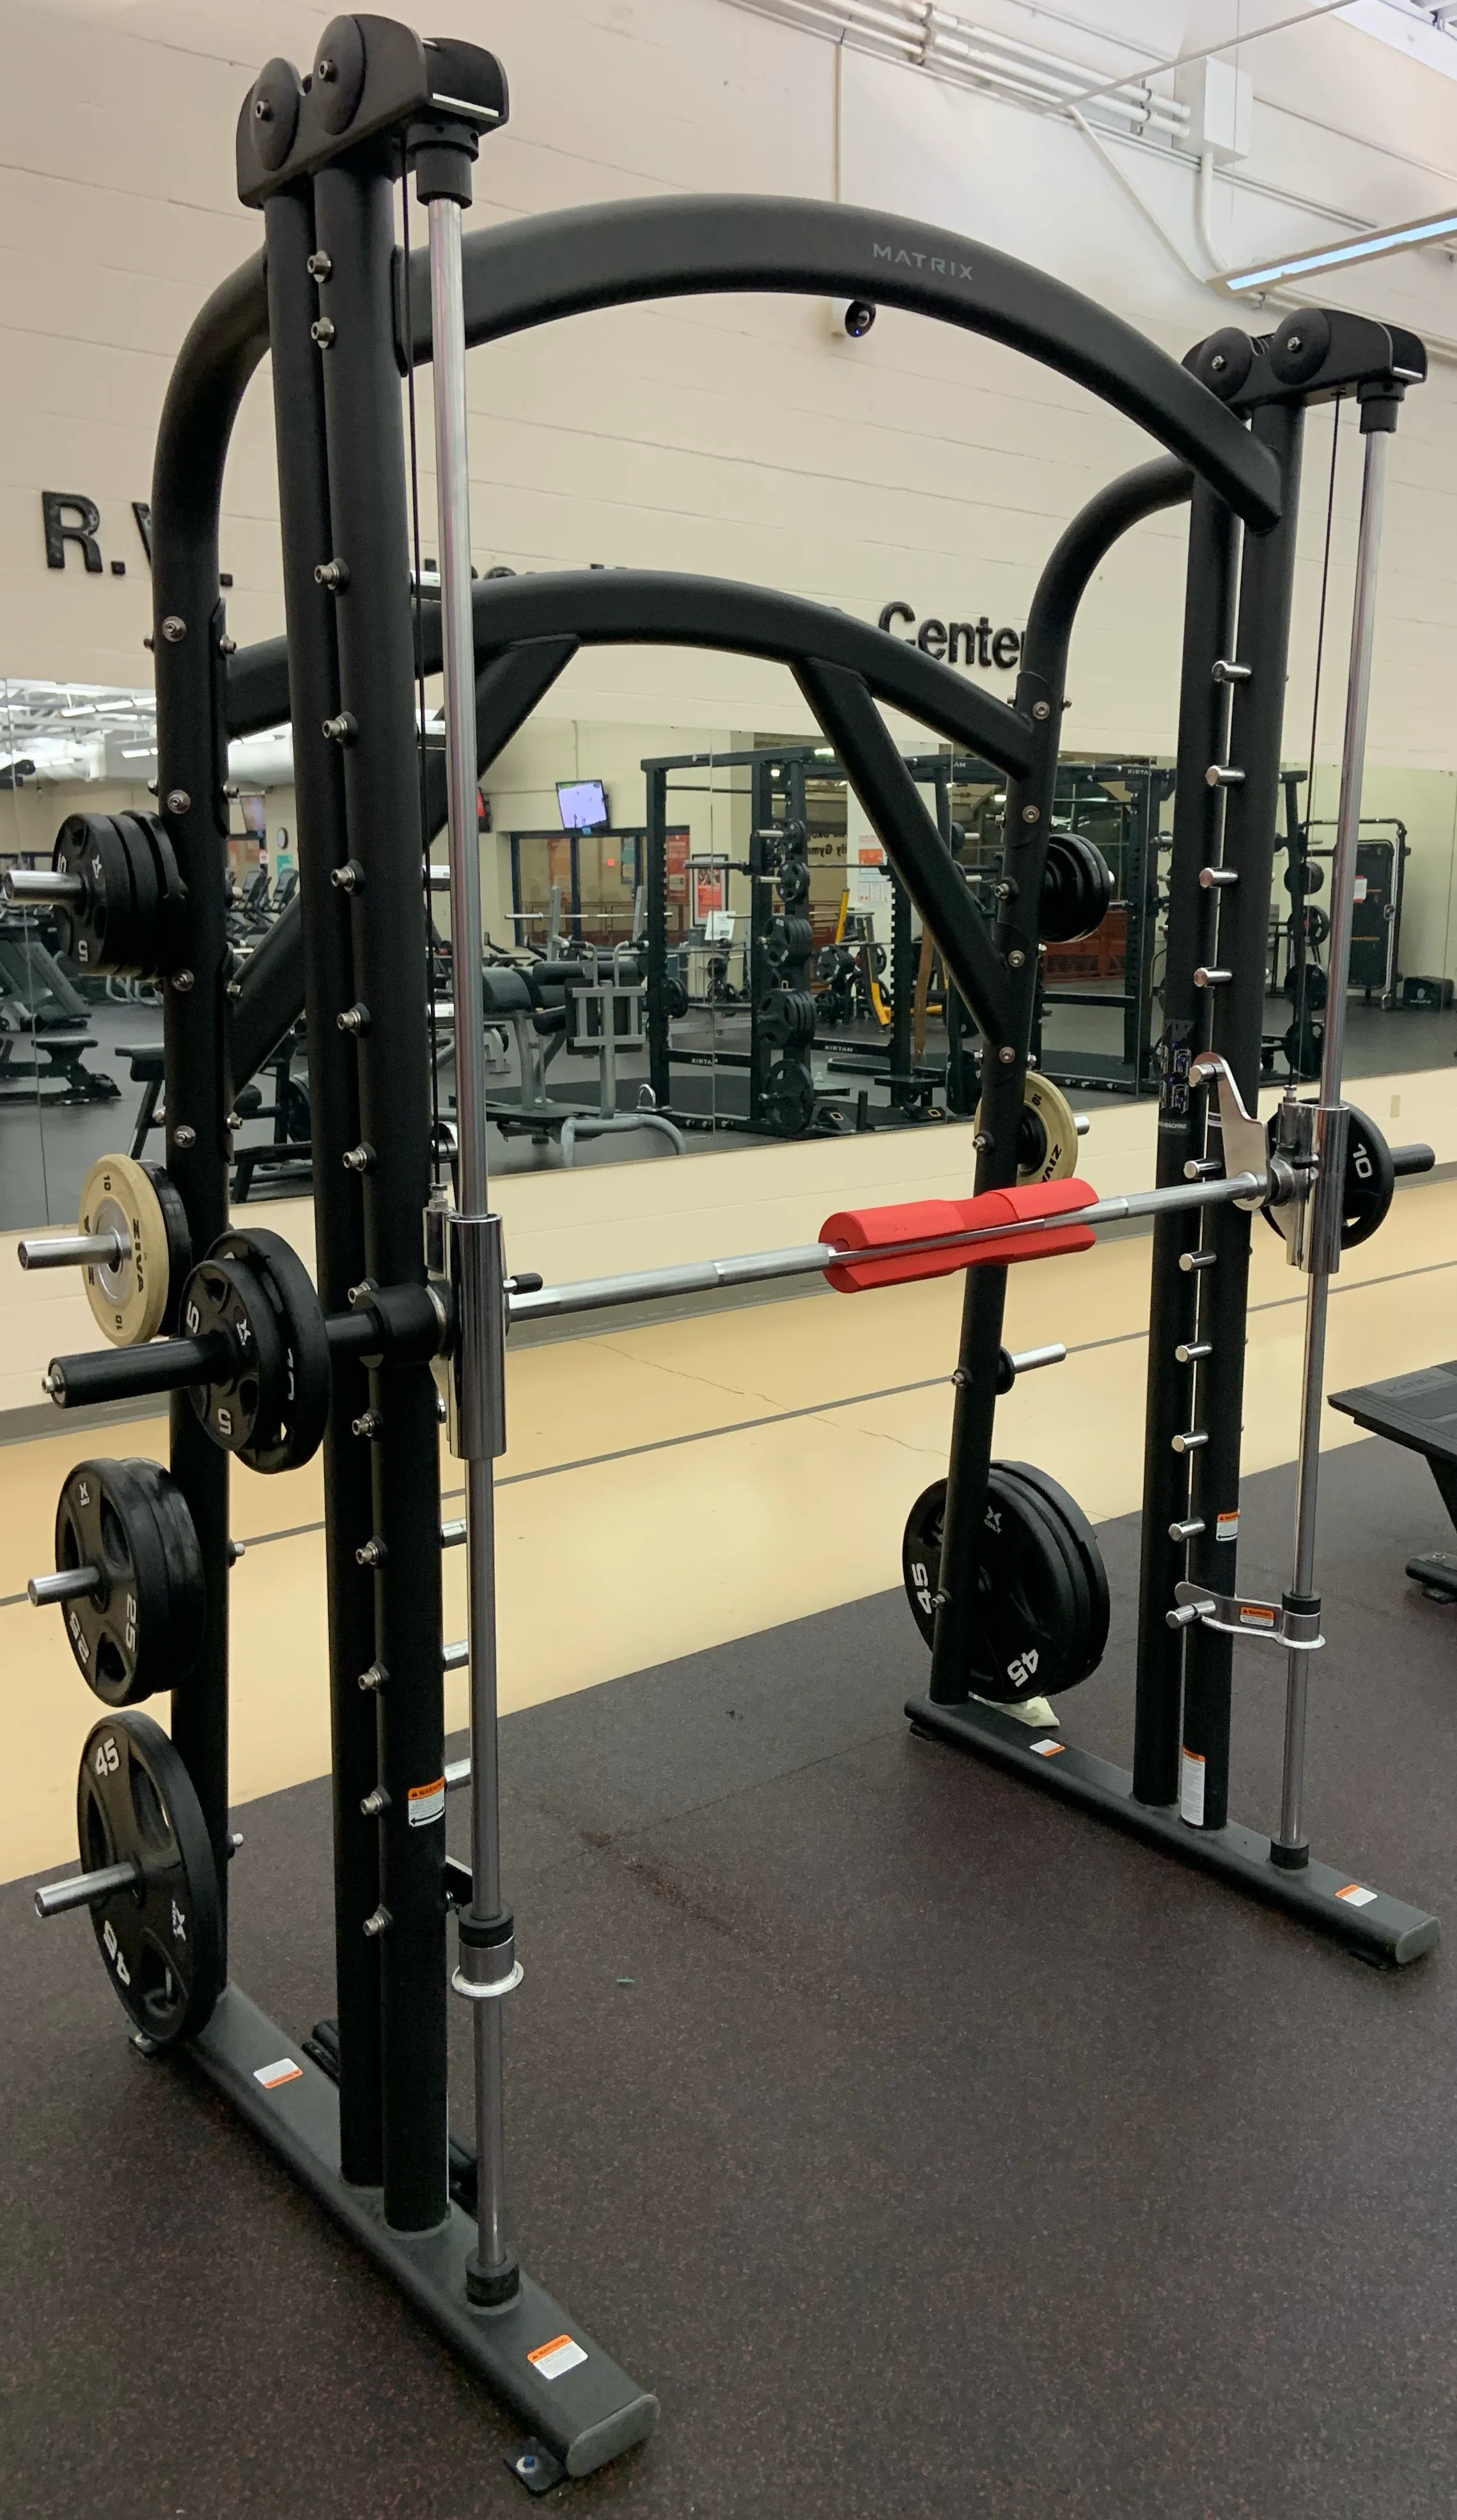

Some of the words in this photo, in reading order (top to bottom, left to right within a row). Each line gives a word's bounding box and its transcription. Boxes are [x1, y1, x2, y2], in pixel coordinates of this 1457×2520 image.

[873, 242, 973, 281] MATRIX
[879, 600, 1027, 669] Cente
[1352, 1143, 1373, 1178] 10
[104, 1175, 111, 1191] 10
[132, 1217, 144, 1294] ZIVA
[115, 1314, 123, 1331] 10
[217, 1407, 231, 1436] 5
[910, 1562, 932, 1615] 45
[125, 1593, 137, 1653] 25
[1006, 1648, 1040, 1687] 45
[95, 1737, 121, 1777] 45
